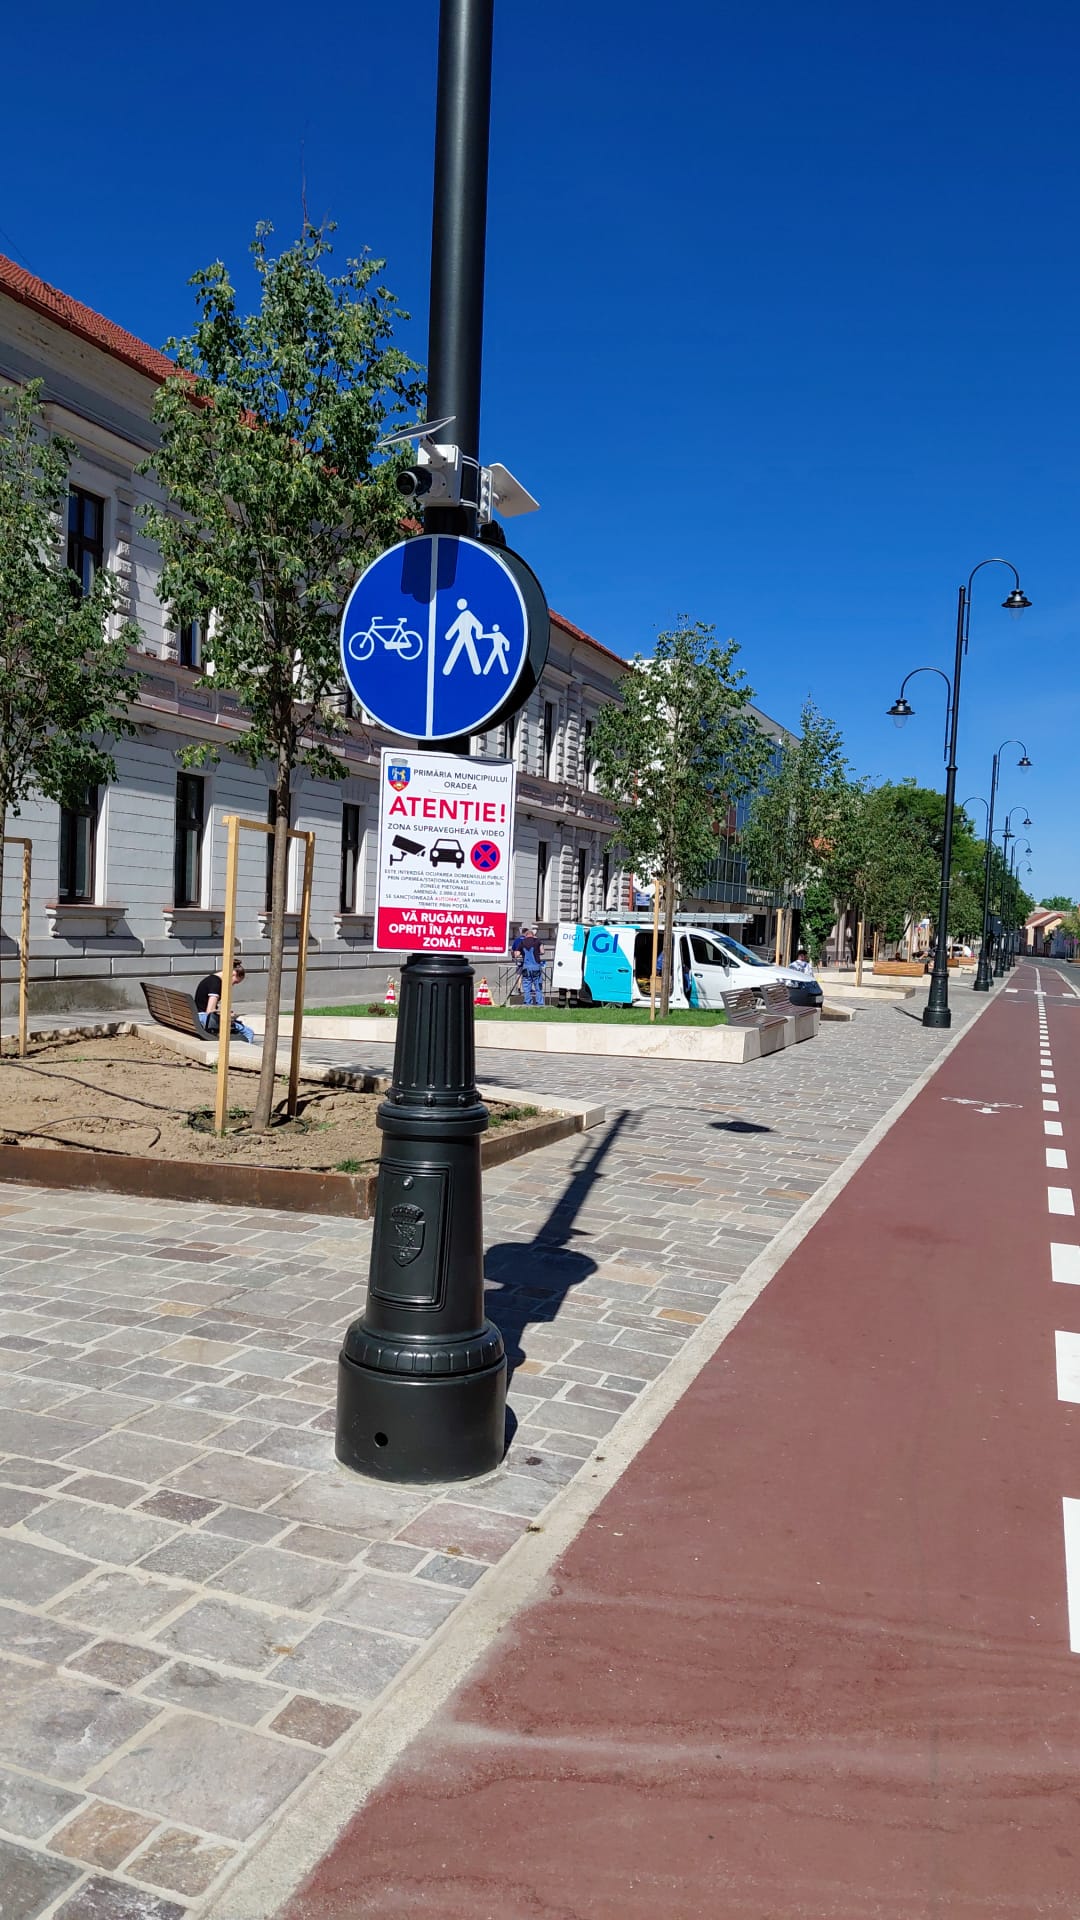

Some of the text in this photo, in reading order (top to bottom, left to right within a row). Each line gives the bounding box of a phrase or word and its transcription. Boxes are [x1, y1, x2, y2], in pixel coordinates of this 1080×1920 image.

[414, 769, 508, 783] PRIMĂRIA MUNICIPIULUI
[444, 781, 477, 790] ORADEA
[389, 796, 506, 824] ATENȚIE!
[387, 823, 411, 831] ZONA
[414, 825, 478, 835] SUPRAVEGHEATĂ
[402, 910, 484, 924] VĂ RUGĂM NU
[388, 923, 495, 937] OPRIȚI ÎN ACEASTĂ
[423, 937, 460, 948] ZONĂ!
[592, 933, 619, 953] GI
